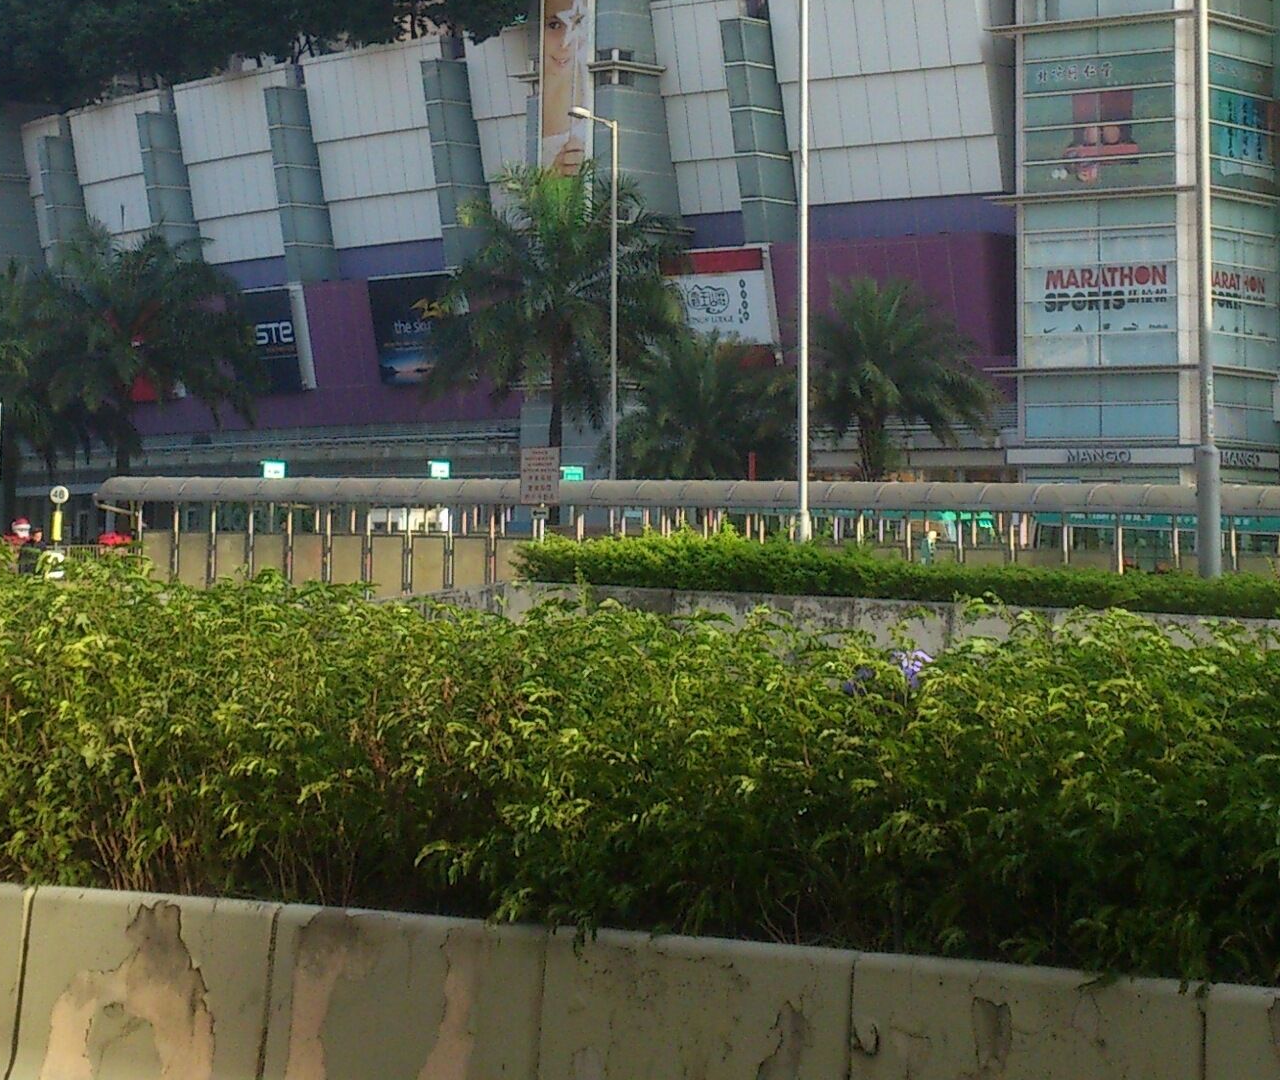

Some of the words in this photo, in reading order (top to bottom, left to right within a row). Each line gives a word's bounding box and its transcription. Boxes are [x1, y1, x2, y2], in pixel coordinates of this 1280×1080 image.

[1045, 264, 1168, 290] MARATHON
[1044, 290, 1126, 312] SPORTS
[1067, 449, 1132, 463] MANGO
